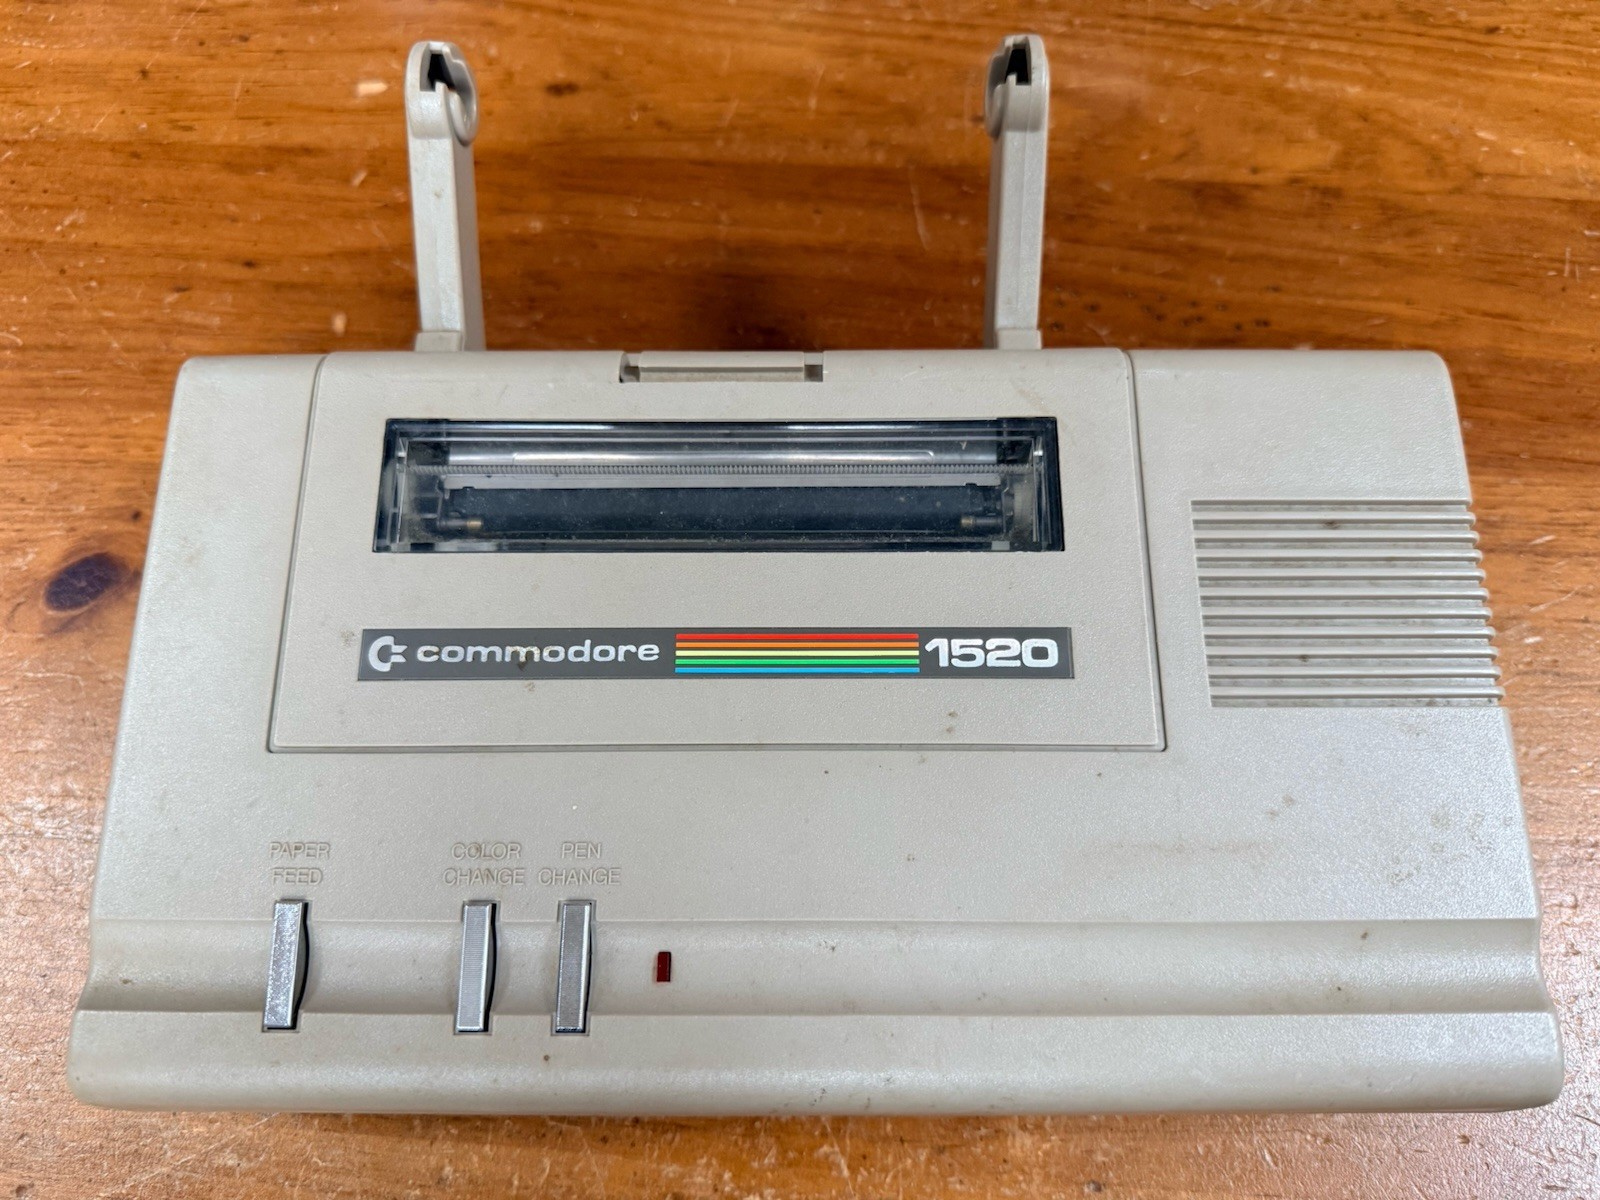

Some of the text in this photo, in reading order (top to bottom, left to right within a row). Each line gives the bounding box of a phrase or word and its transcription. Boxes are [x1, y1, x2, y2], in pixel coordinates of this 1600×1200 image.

[416, 637, 1059, 668] commodore 1520
[269, 841, 331, 860] PAPER
[451, 842, 522, 860] COLOR
[560, 842, 603, 860] PEN
[271, 867, 323, 885] FEED
[443, 868, 526, 886] CHANGE
[538, 868, 622, 886] CHANGE
